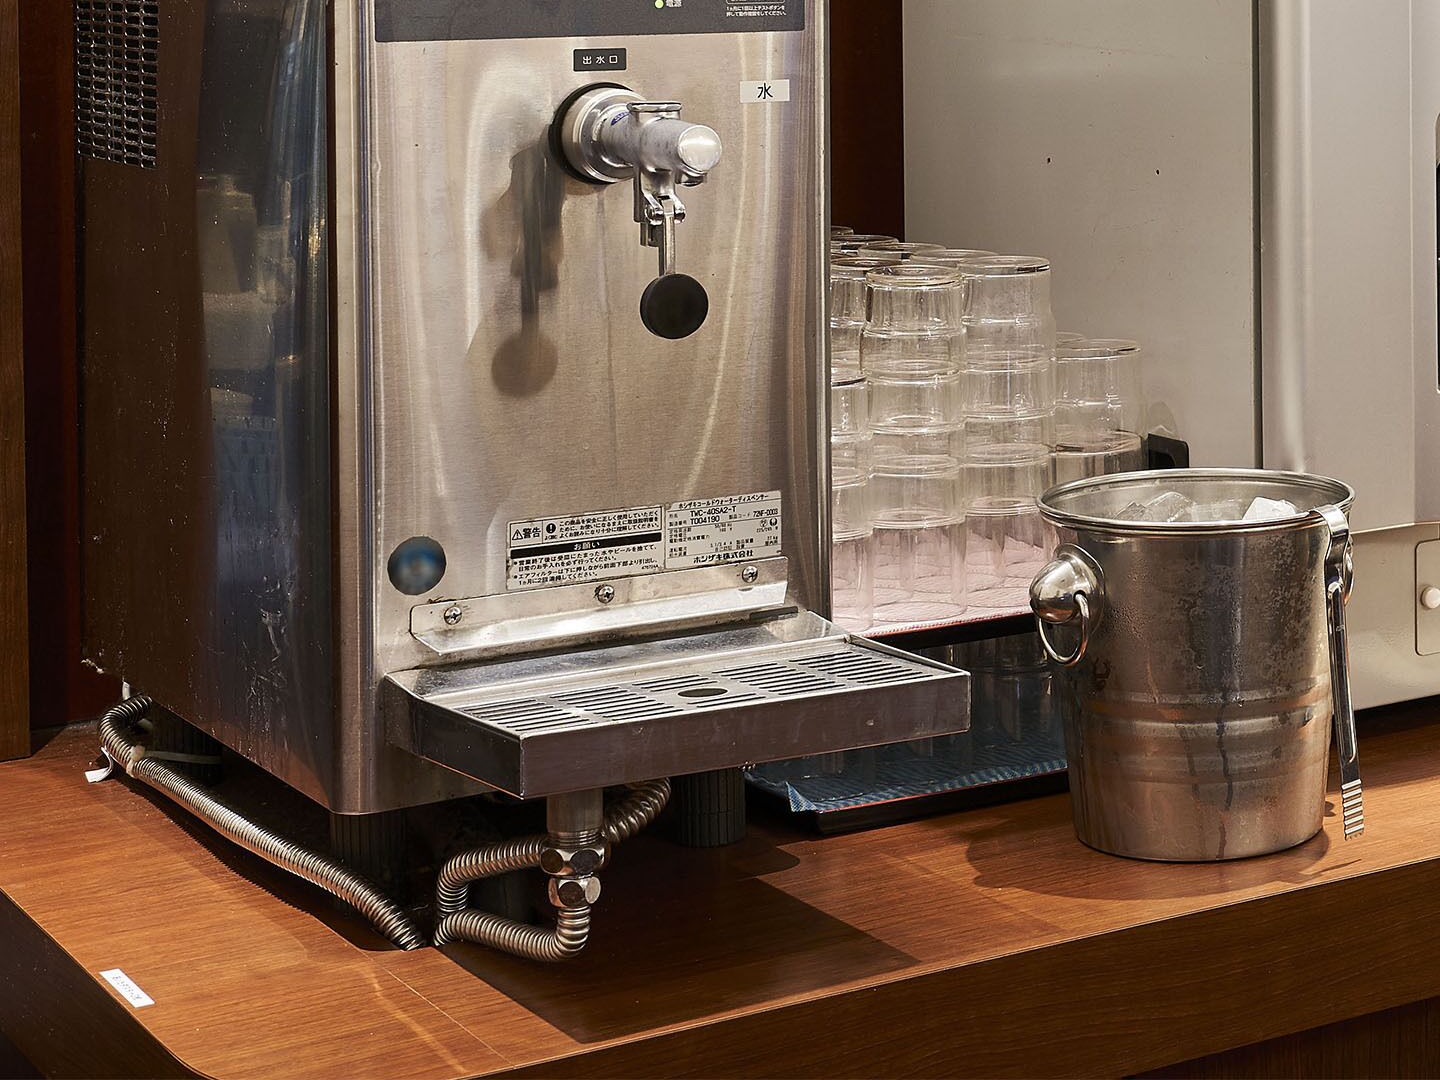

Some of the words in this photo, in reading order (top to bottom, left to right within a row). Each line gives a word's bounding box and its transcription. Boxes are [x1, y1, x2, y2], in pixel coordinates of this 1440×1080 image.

[582, 53, 619, 65] 出水口
[757, 83, 773, 101] 水
[522, 527, 541, 539] 警告
[573, 541, 601, 551] お願い
[693, 550, 753, 564] ホシザキ株式会社
